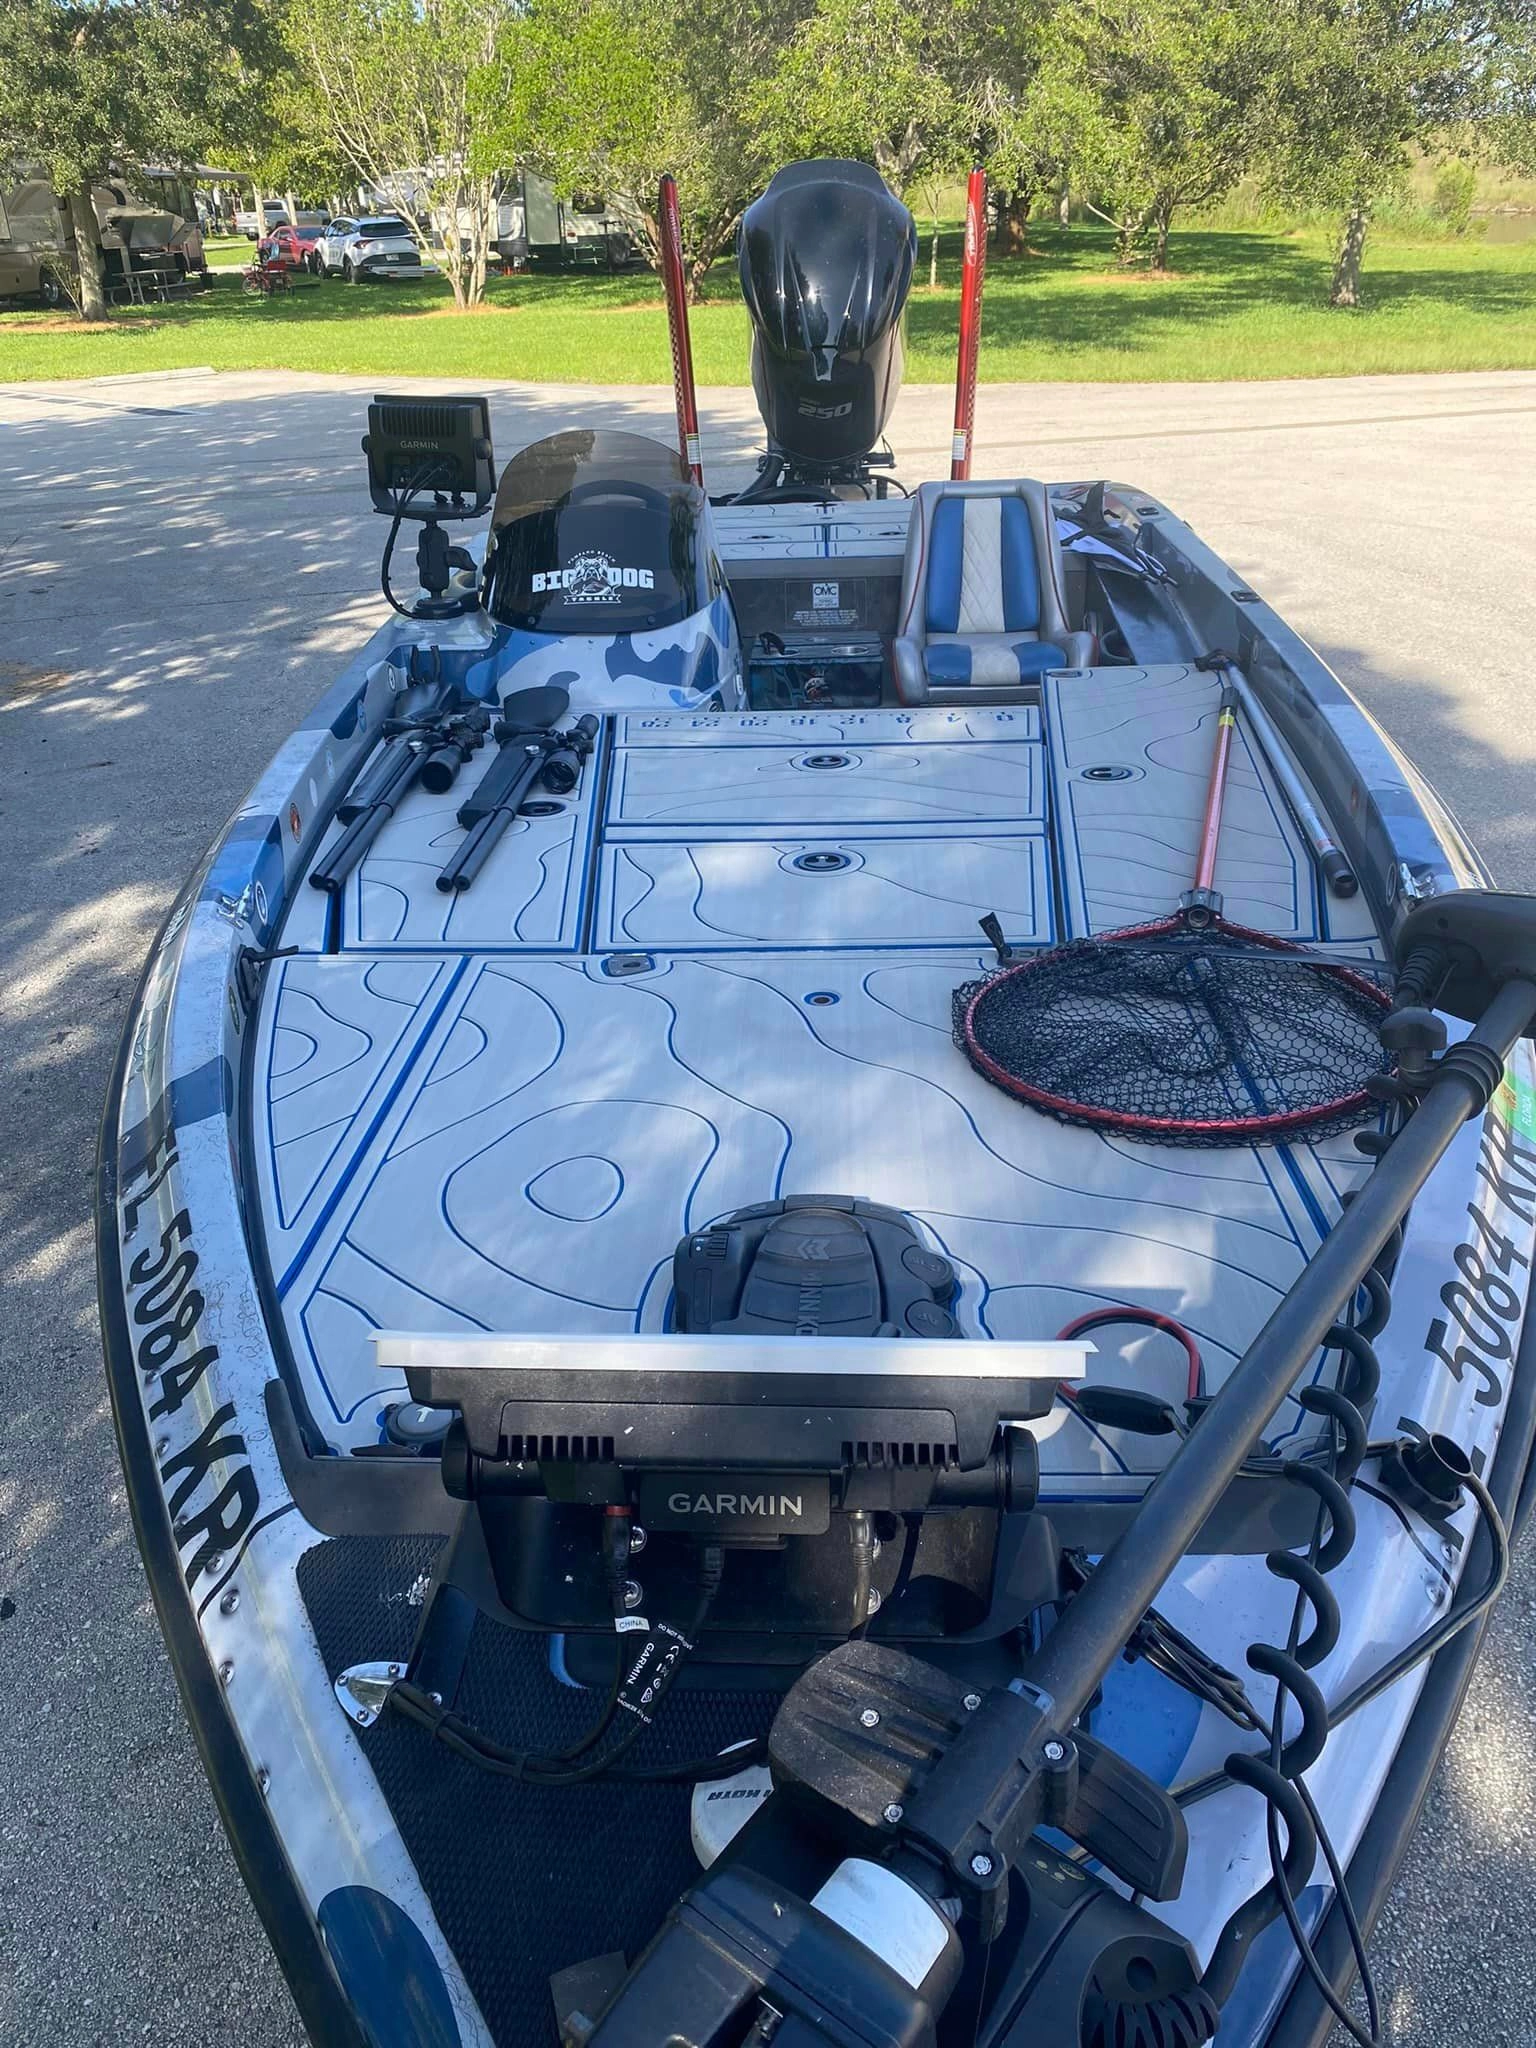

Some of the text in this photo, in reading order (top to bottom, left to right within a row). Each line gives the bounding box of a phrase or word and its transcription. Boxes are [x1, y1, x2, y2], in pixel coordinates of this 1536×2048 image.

[798, 402, 853, 419] 250
[400, 440, 439, 449] GARMIN
[532, 567, 655, 593] BIG DOG
[814, 585, 837, 596] OMC
[1475, 1111, 1536, 1226] KR
[799, 1268, 824, 1312] MINN
[1425, 1202, 1529, 1407] 5084
[130, 1208, 220, 1423] 5084
[160, 1402, 260, 1593] KR
[668, 1493, 802, 1516] GARMIN
[626, 1642, 655, 1685] GARMIN
